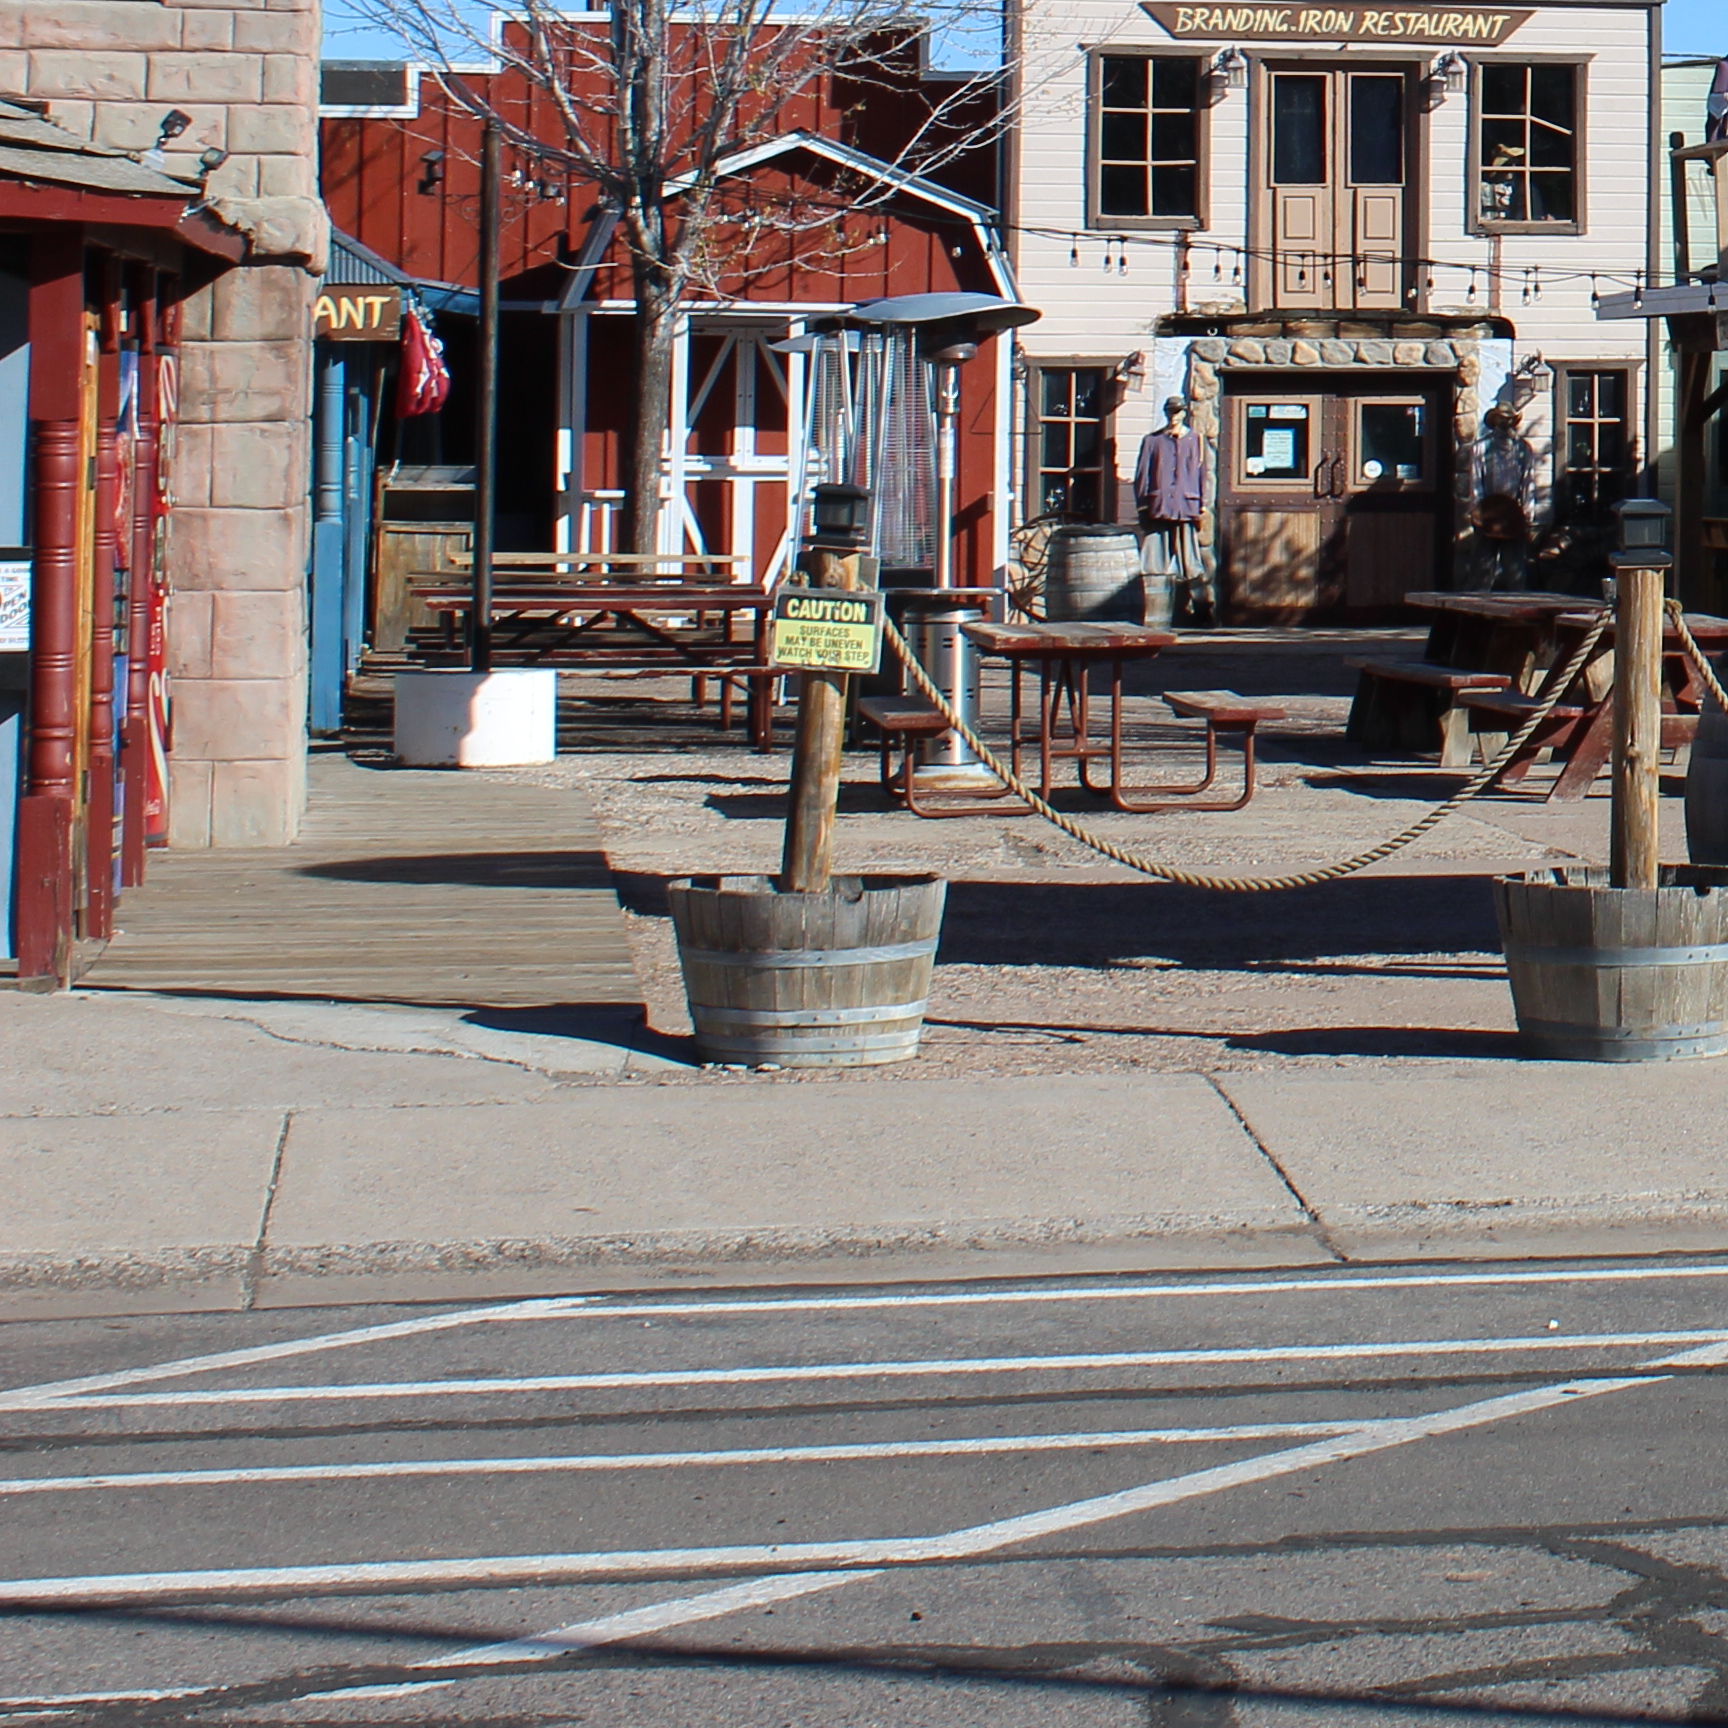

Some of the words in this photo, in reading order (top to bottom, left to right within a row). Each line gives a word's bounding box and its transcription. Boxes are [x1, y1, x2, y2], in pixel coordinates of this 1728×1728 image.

[1359, 11, 1511, 39] RESTAURANT
[786, 598, 867, 623] CAUTION
[799, 625, 851, 638] SURFACES
[784, 635, 807, 646] MAY
[809, 637, 823, 647] BE
[824, 639, 864, 650] UNEVEN
[777, 646, 813, 659] WATCH
[844, 651, 870, 662] STEP
